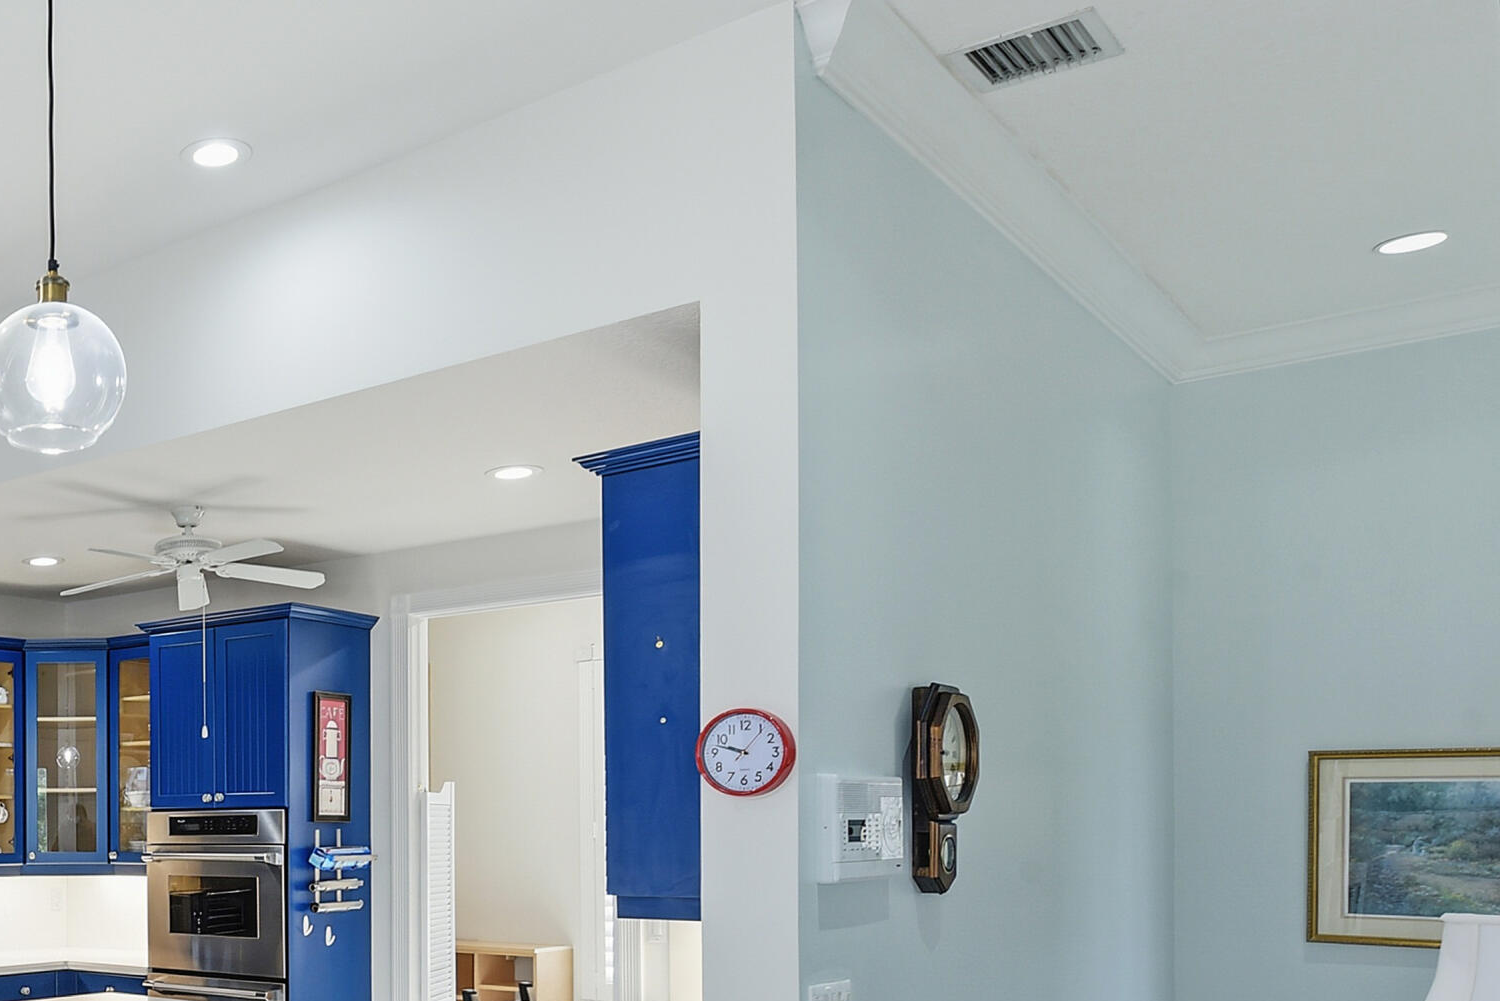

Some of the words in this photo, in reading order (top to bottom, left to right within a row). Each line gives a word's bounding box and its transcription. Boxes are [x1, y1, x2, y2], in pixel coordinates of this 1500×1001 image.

[728, 724, 736, 735] 11
[740, 720, 752, 731] 12
[716, 733, 728, 745] 10
[767, 732, 775, 744] 2
[711, 747, 719, 758] 9
[772, 746, 780, 758] 3
[715, 761, 723, 773] 8
[765, 761, 774, 772] 4
[727, 771, 736, 783] 7
[740, 774, 748, 786] 6
[754, 770, 762, 783] 5
